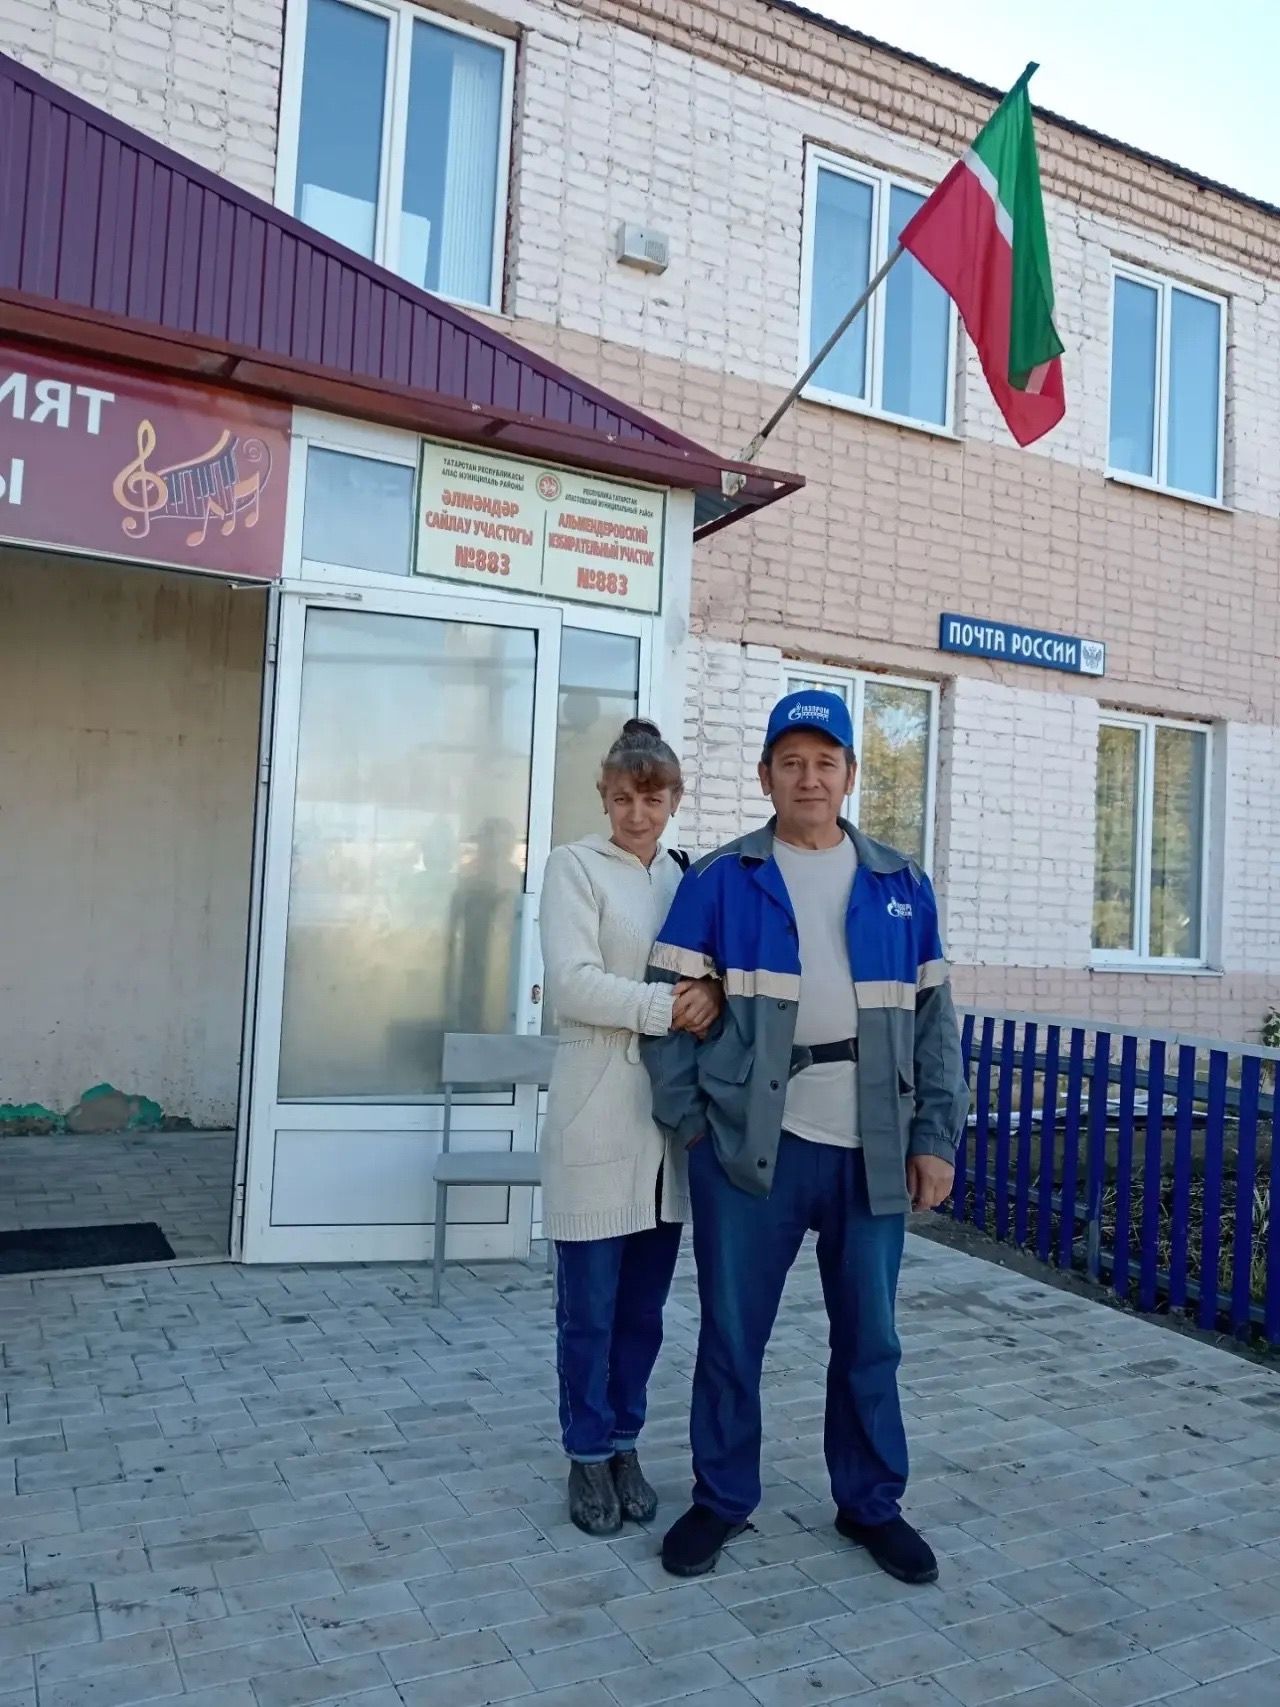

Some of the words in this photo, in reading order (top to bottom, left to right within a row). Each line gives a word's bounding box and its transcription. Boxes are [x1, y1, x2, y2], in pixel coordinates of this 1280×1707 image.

[425, 509, 472, 535] САЙЛАУ
[473, 519, 534, 546] УЧАСТОГЫ
[558, 512, 649, 544] АЛЬМЕНДЕРОВСКИЙ
[454, 544, 511, 576] №883
[548, 532, 619, 560] ИЗБИРАТЕЛЬНЫЙ
[619, 545, 655, 567] УЧАСТОК
[577, 566, 629, 596] №883
[950, 621, 1005, 652] ПОЧТА
[1012, 632, 1076, 665] РОССИИ
